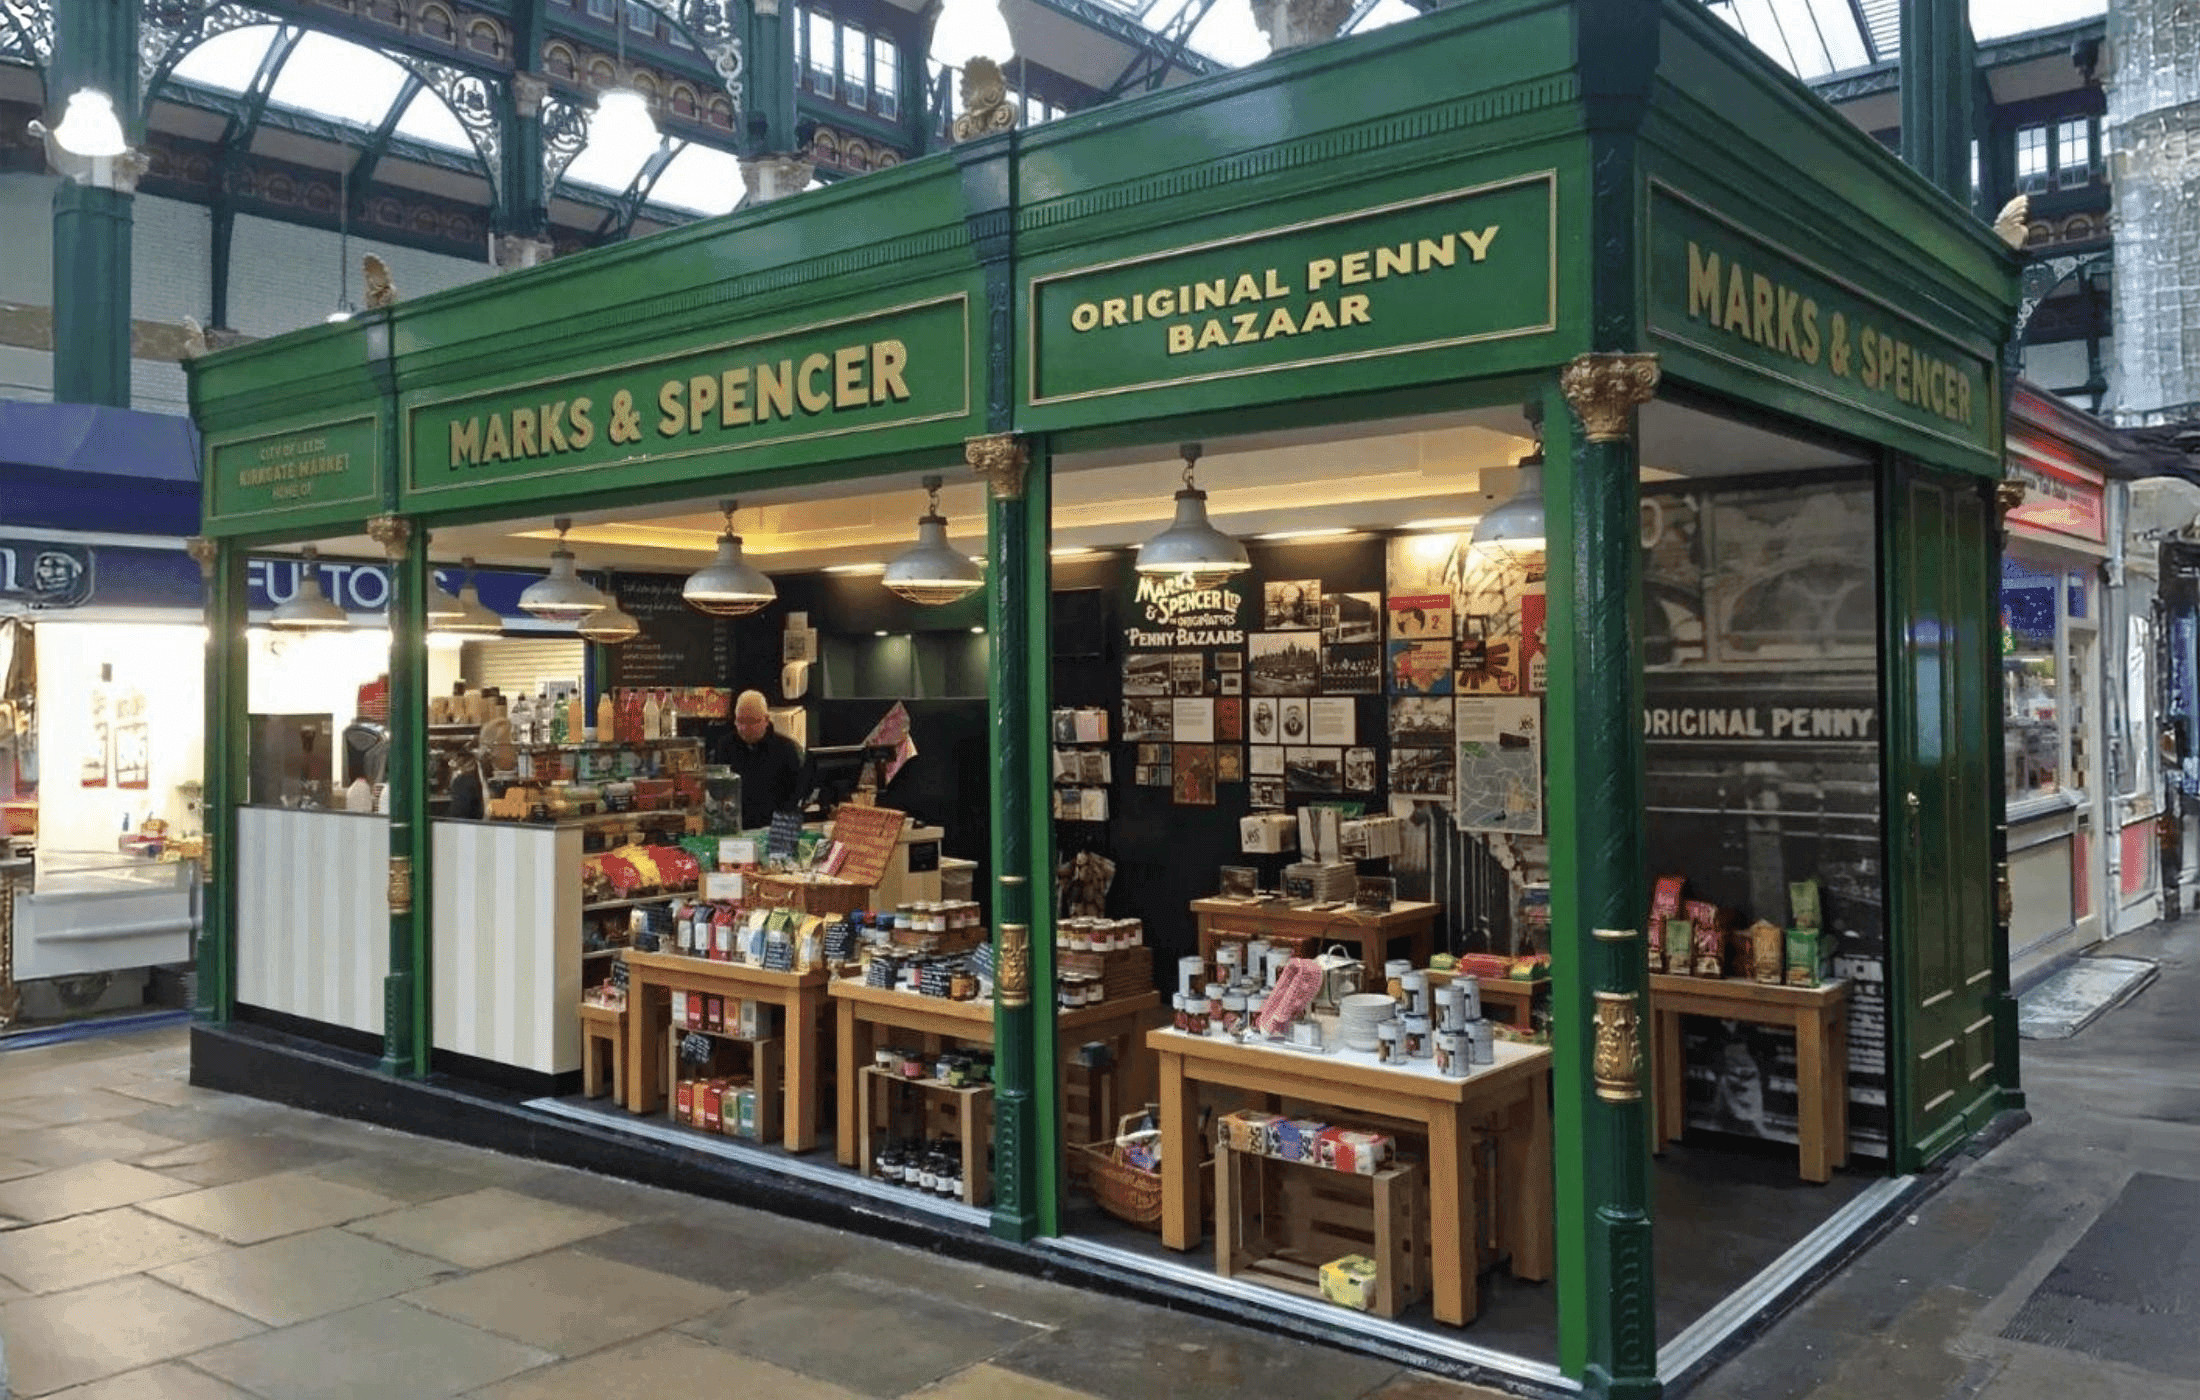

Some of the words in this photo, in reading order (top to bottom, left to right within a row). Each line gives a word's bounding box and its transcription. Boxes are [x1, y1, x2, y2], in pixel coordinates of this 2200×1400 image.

[1071, 269, 1290, 331] ORIGINAL
[1307, 226, 1499, 291] PENNY
[1167, 294, 1372, 354] BAZAAR
[1688, 241, 1820, 365] MARKS
[1830, 311, 1849, 377] &
[1860, 324, 1972, 426] SPENCER
[449, 397, 595, 468] MARKS
[609, 389, 642, 444] &
[658, 339, 911, 437] SPENCER
[299, 453, 349, 478] MARKET
[1145, 604, 1158, 621] &
[1157, 589, 1222, 625] SPENCER
[1129, 627, 1175, 647] PENNY
[1176, 628, 1244, 646] BAZAARS
[1771, 708, 1874, 737] PENNY
